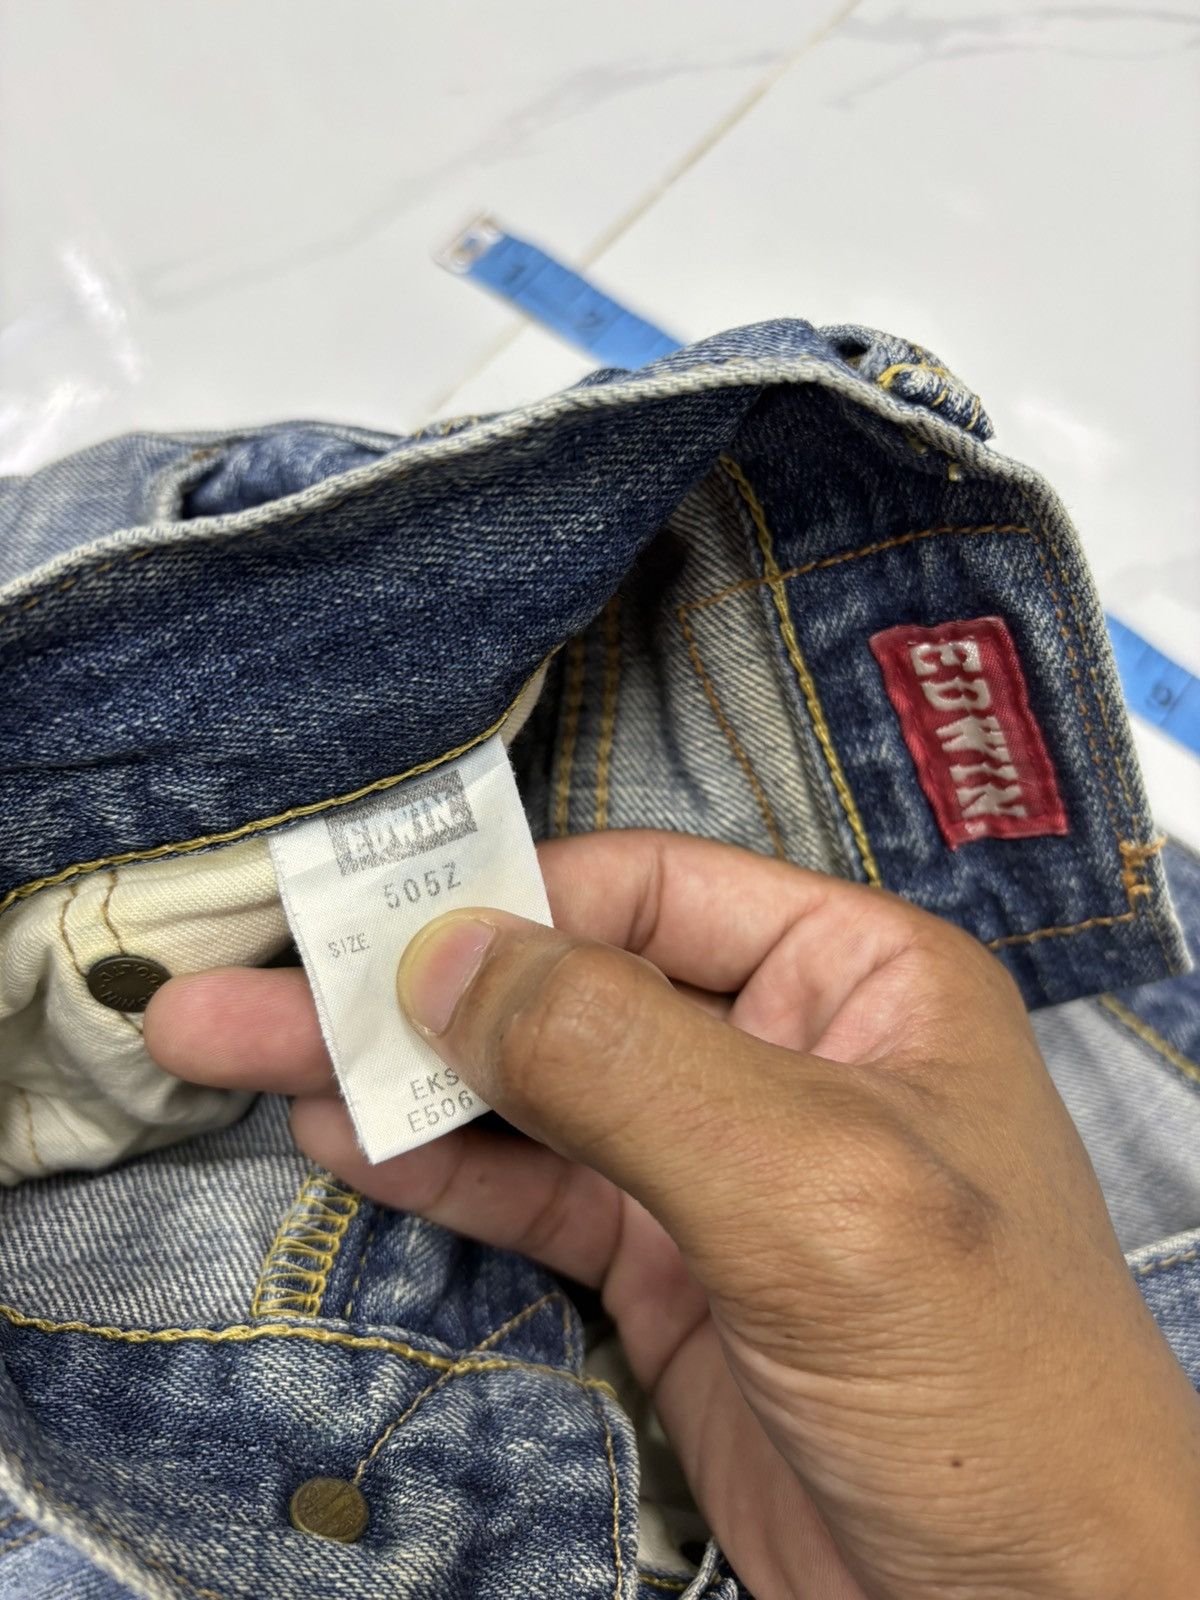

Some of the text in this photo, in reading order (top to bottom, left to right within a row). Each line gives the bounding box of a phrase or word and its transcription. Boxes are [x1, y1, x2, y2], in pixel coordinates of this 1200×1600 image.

[327, 932, 371, 959] SIZE
[409, 1067, 460, 1101] EKS
[406, 1089, 474, 1133] E506
